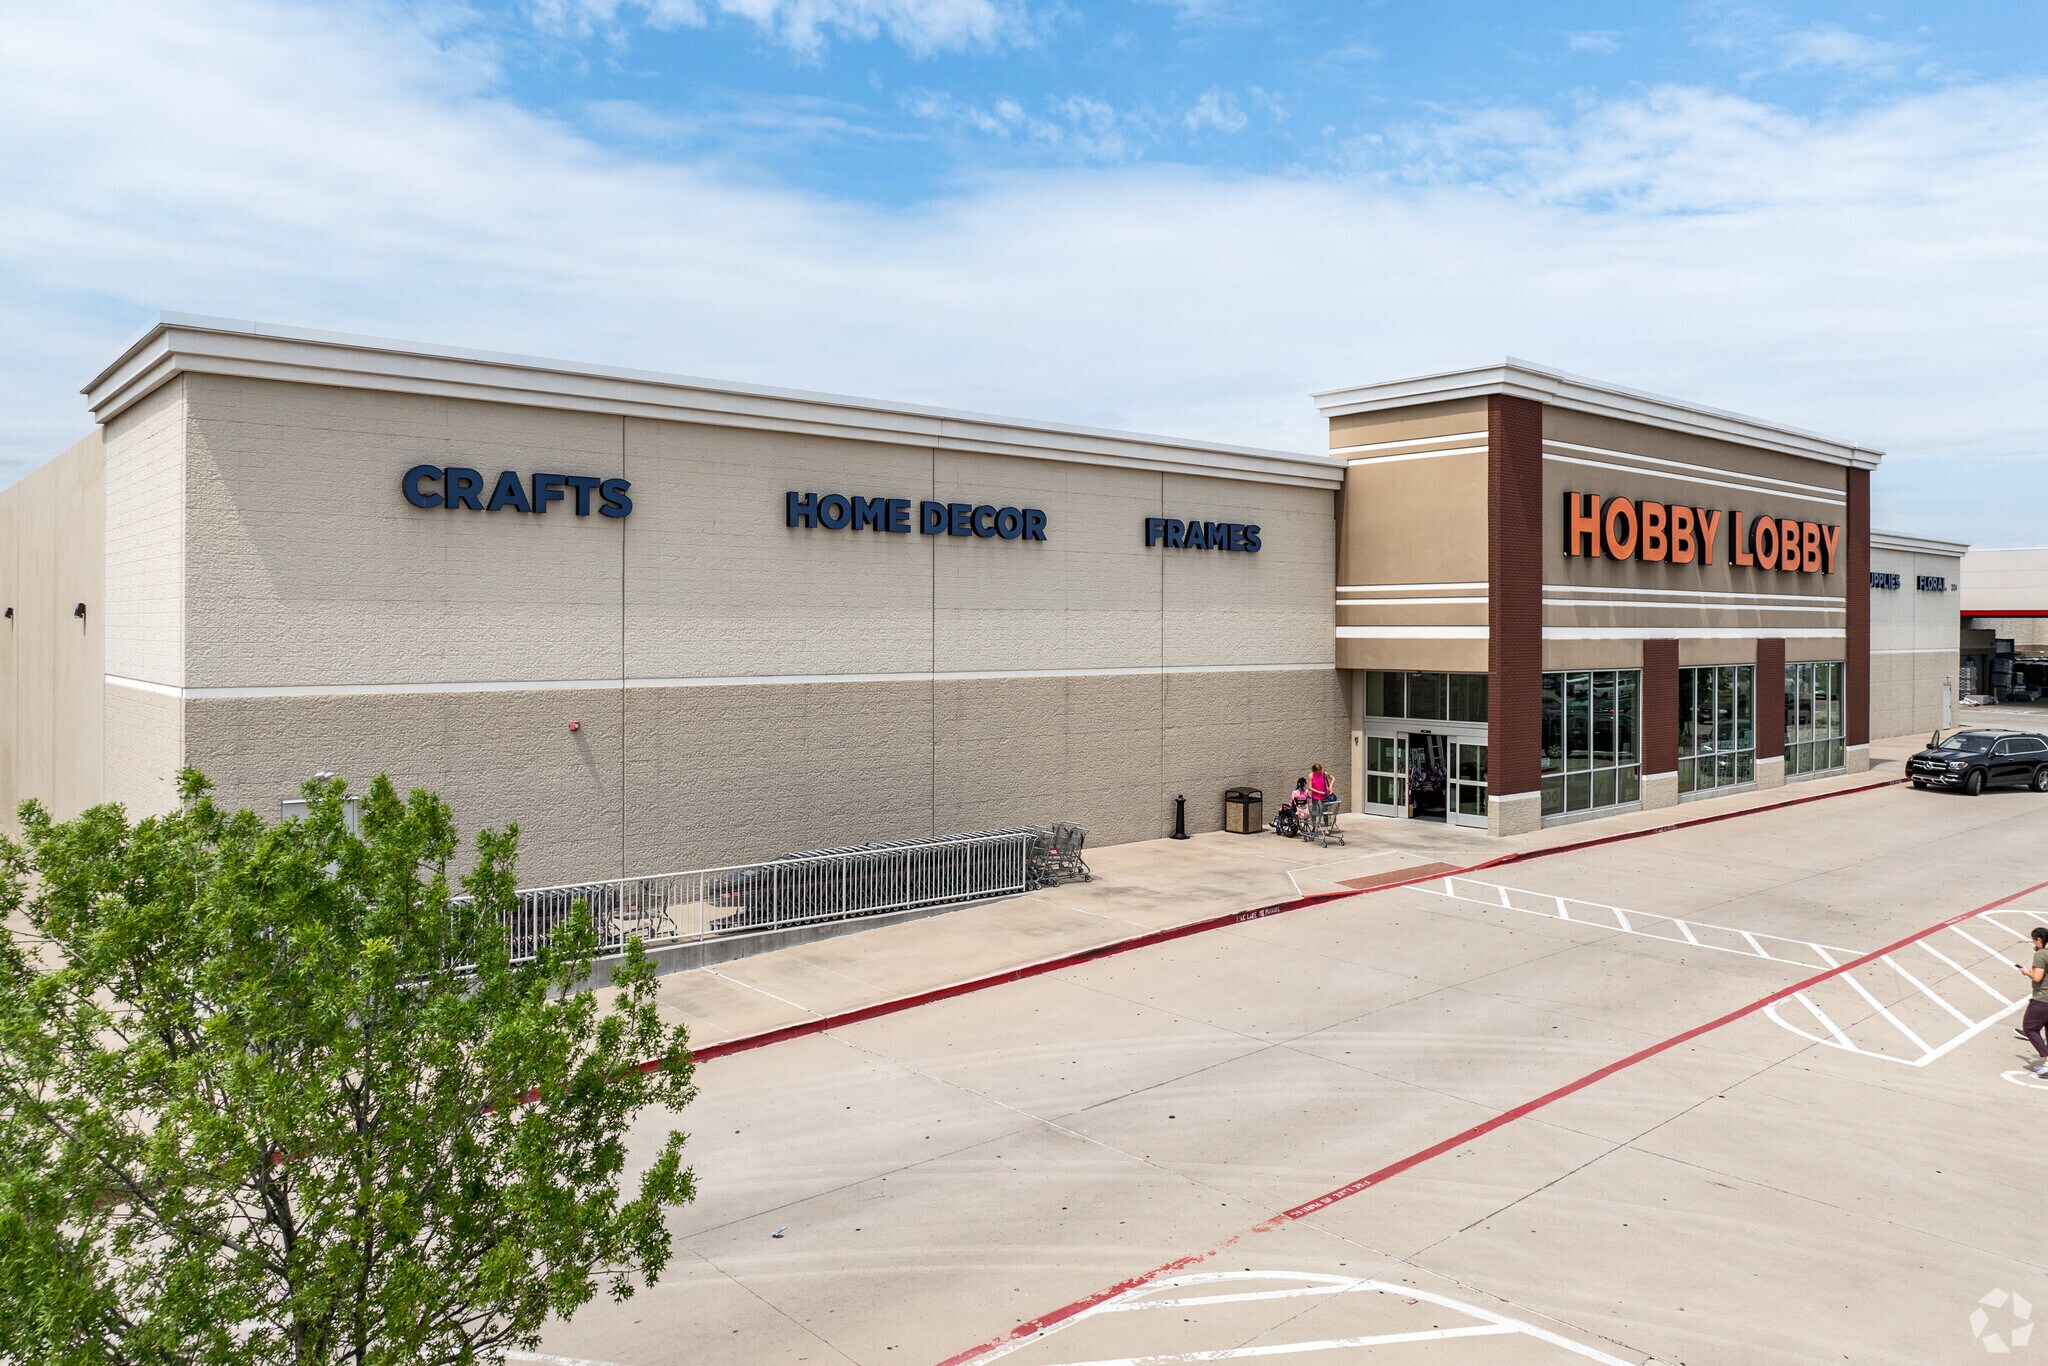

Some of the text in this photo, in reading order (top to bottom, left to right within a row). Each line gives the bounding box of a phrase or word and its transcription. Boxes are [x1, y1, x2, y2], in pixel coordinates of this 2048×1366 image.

[402, 464, 633, 518] CRAFTS
[786, 491, 1047, 541] HOME DECOR
[1145, 518, 1262, 552] FRAMES
[1563, 491, 1840, 574] HOBBY LOBBY
[1870, 572, 1900, 590] UPPLIES
[1917, 576, 1947, 592] FLORAL
